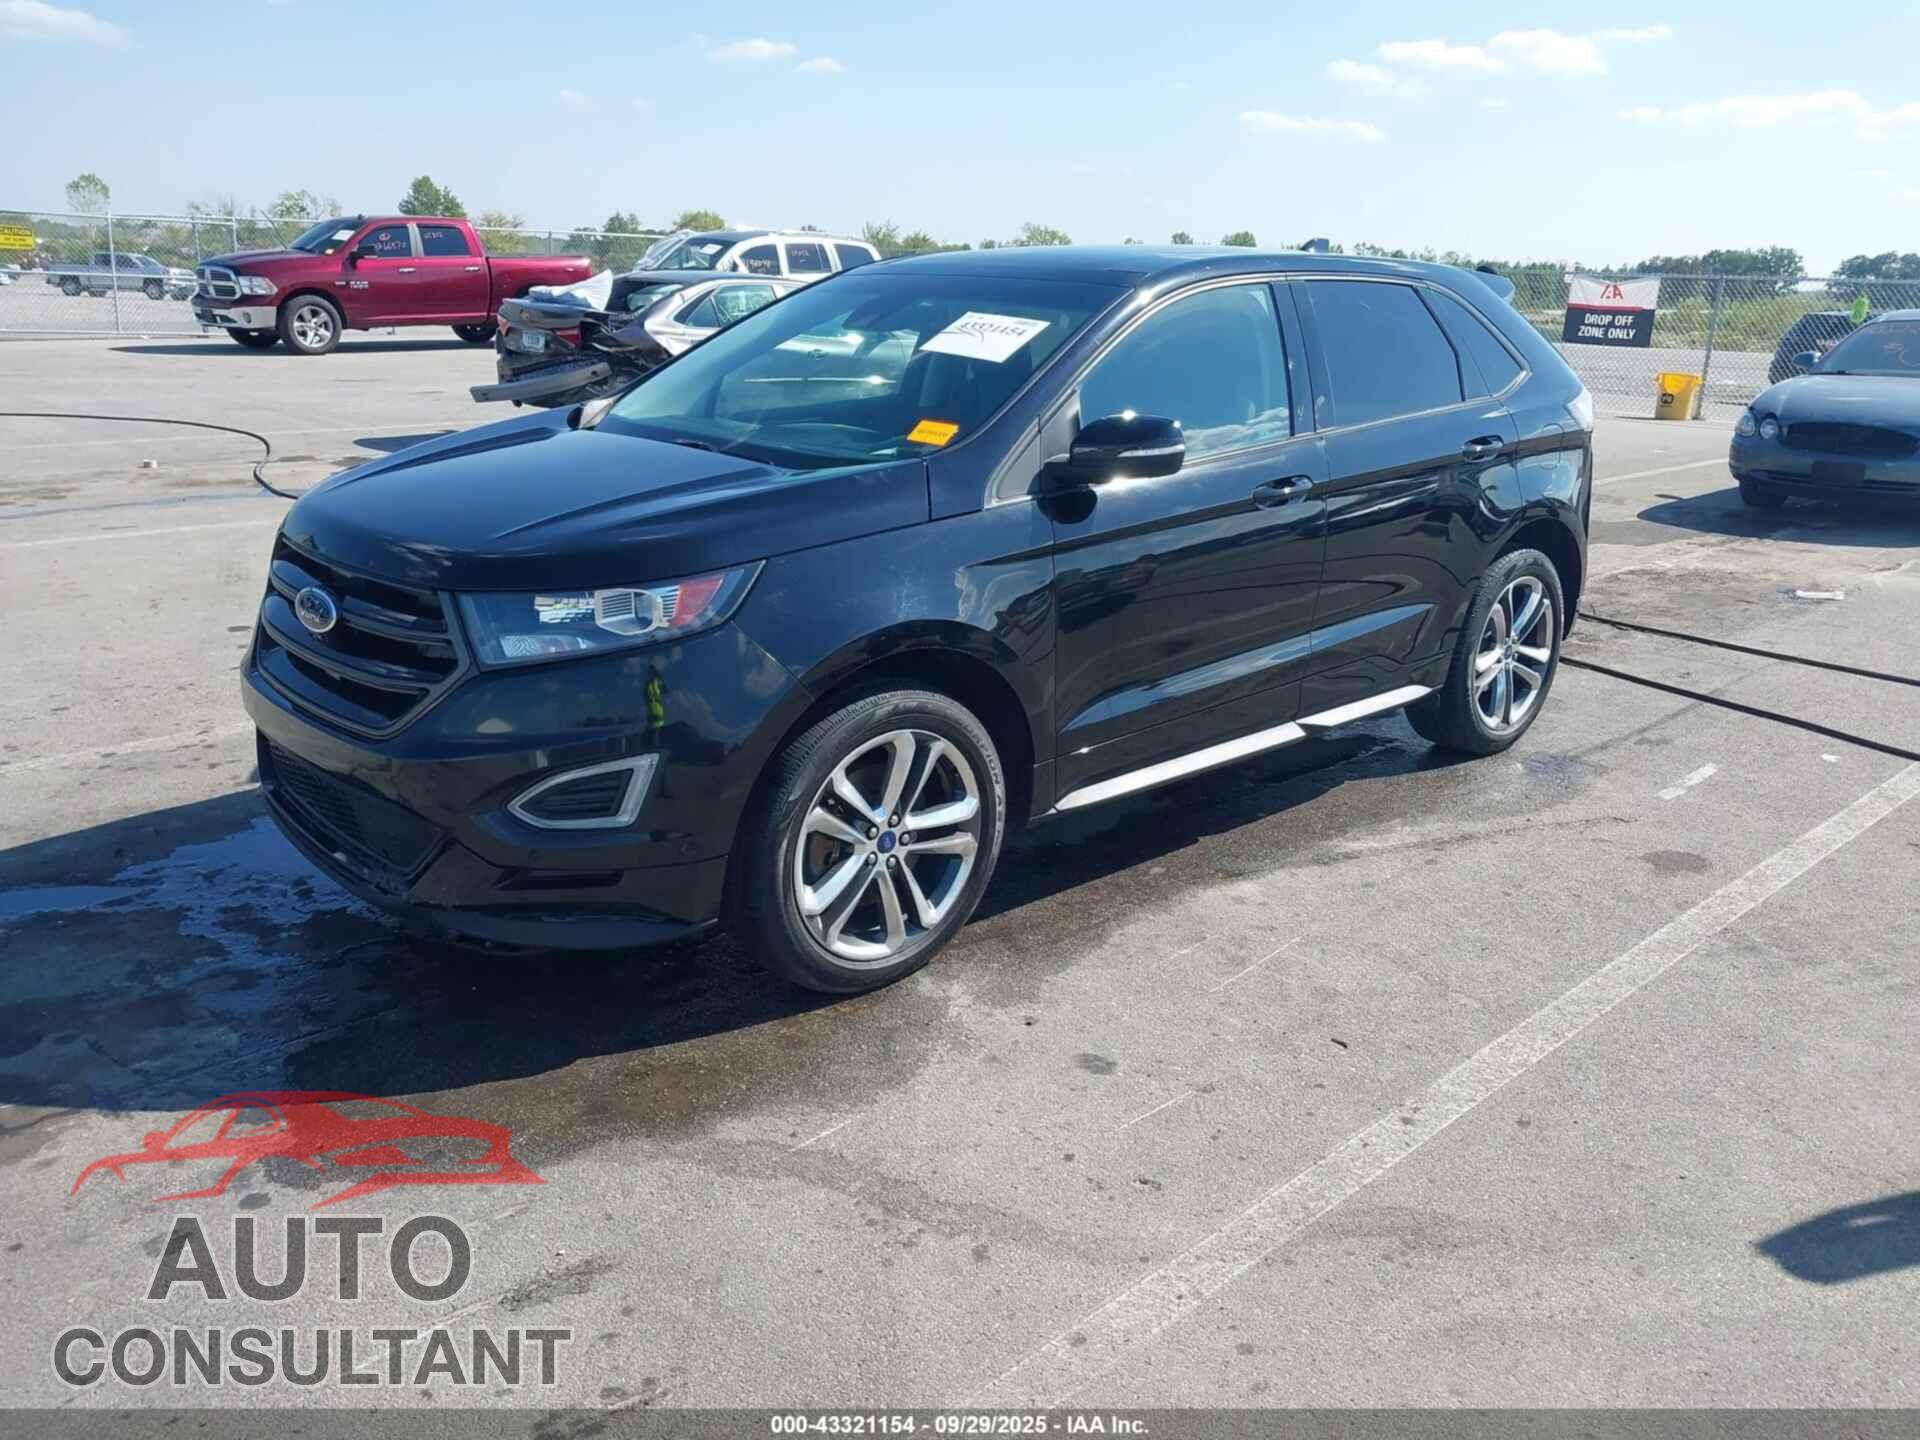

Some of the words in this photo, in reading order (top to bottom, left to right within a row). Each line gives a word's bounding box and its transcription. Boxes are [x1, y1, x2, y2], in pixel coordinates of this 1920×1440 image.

[1584, 313, 1612, 326] DROP
[1614, 315, 1634, 326] OFF
[1578, 326, 1607, 338] ZONE
[1608, 328, 1636, 339] ONLY
